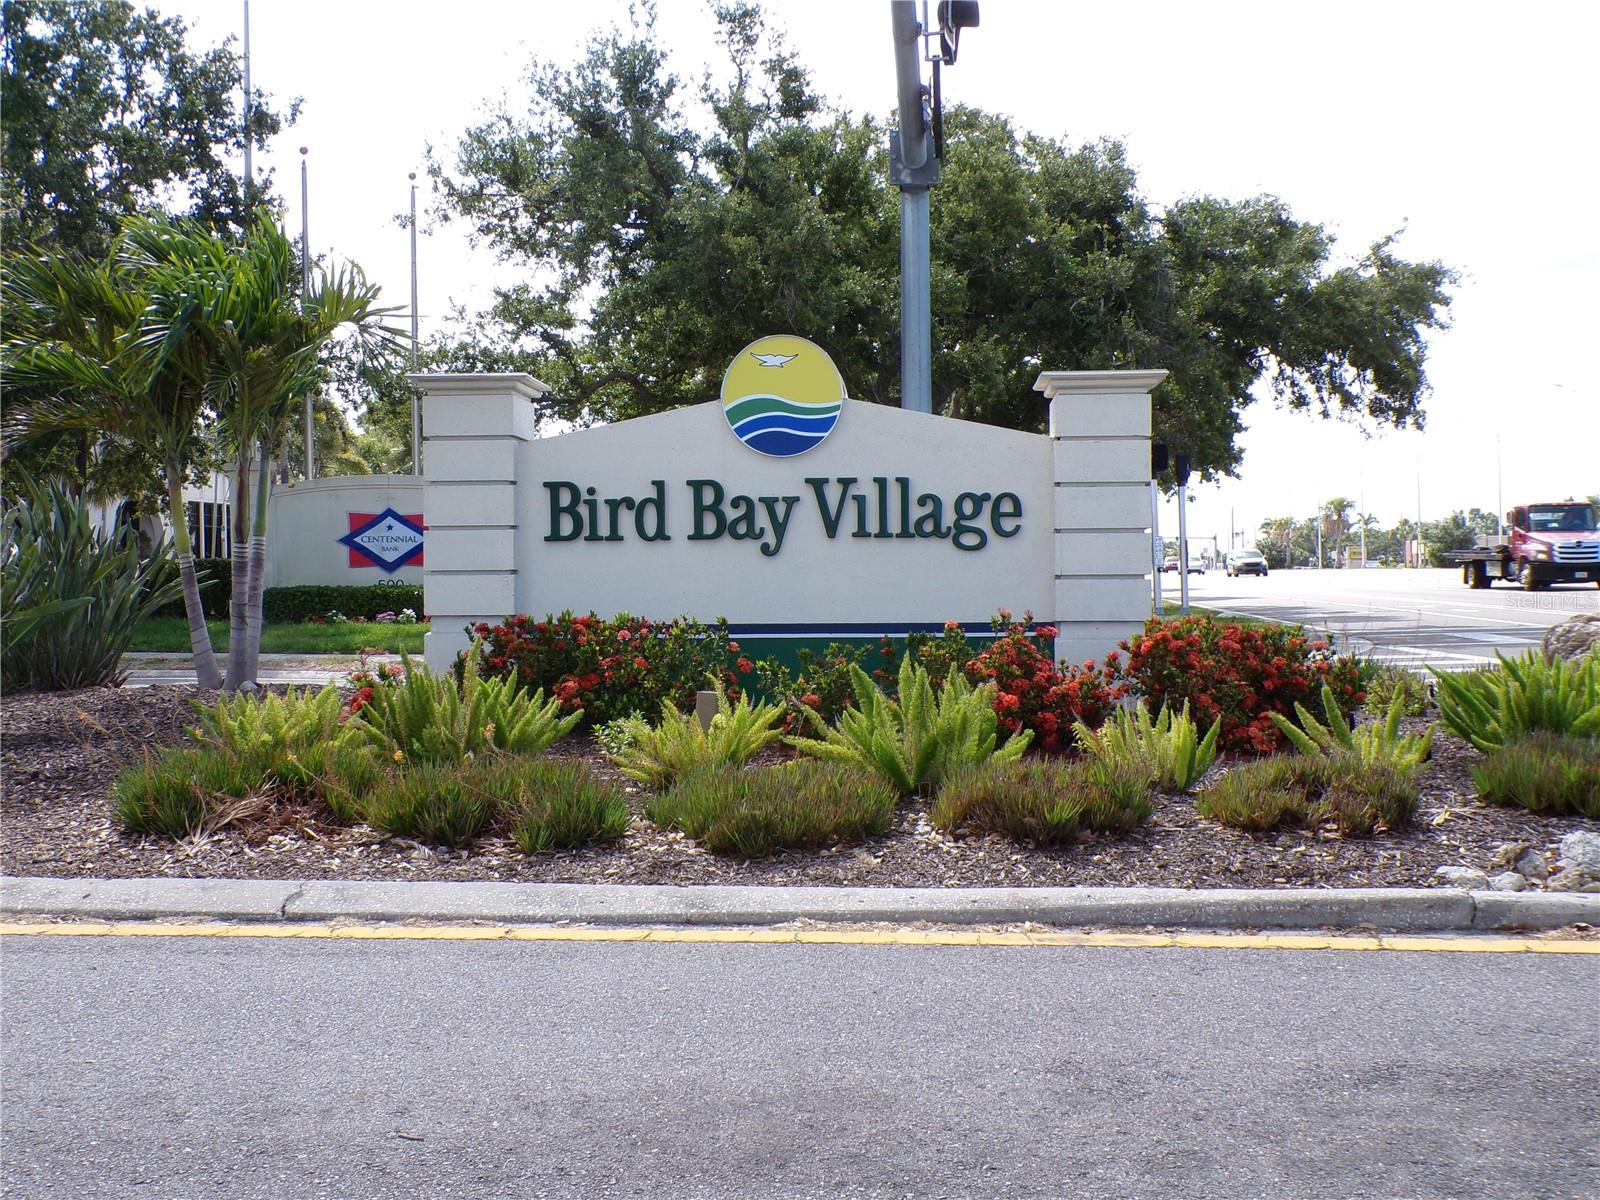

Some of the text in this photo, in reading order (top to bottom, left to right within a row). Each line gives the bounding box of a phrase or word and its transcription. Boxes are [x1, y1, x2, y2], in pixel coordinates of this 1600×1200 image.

[361, 535, 417, 543] CENTENNIAL
[543, 477, 1022, 557] Bird Bay Village
